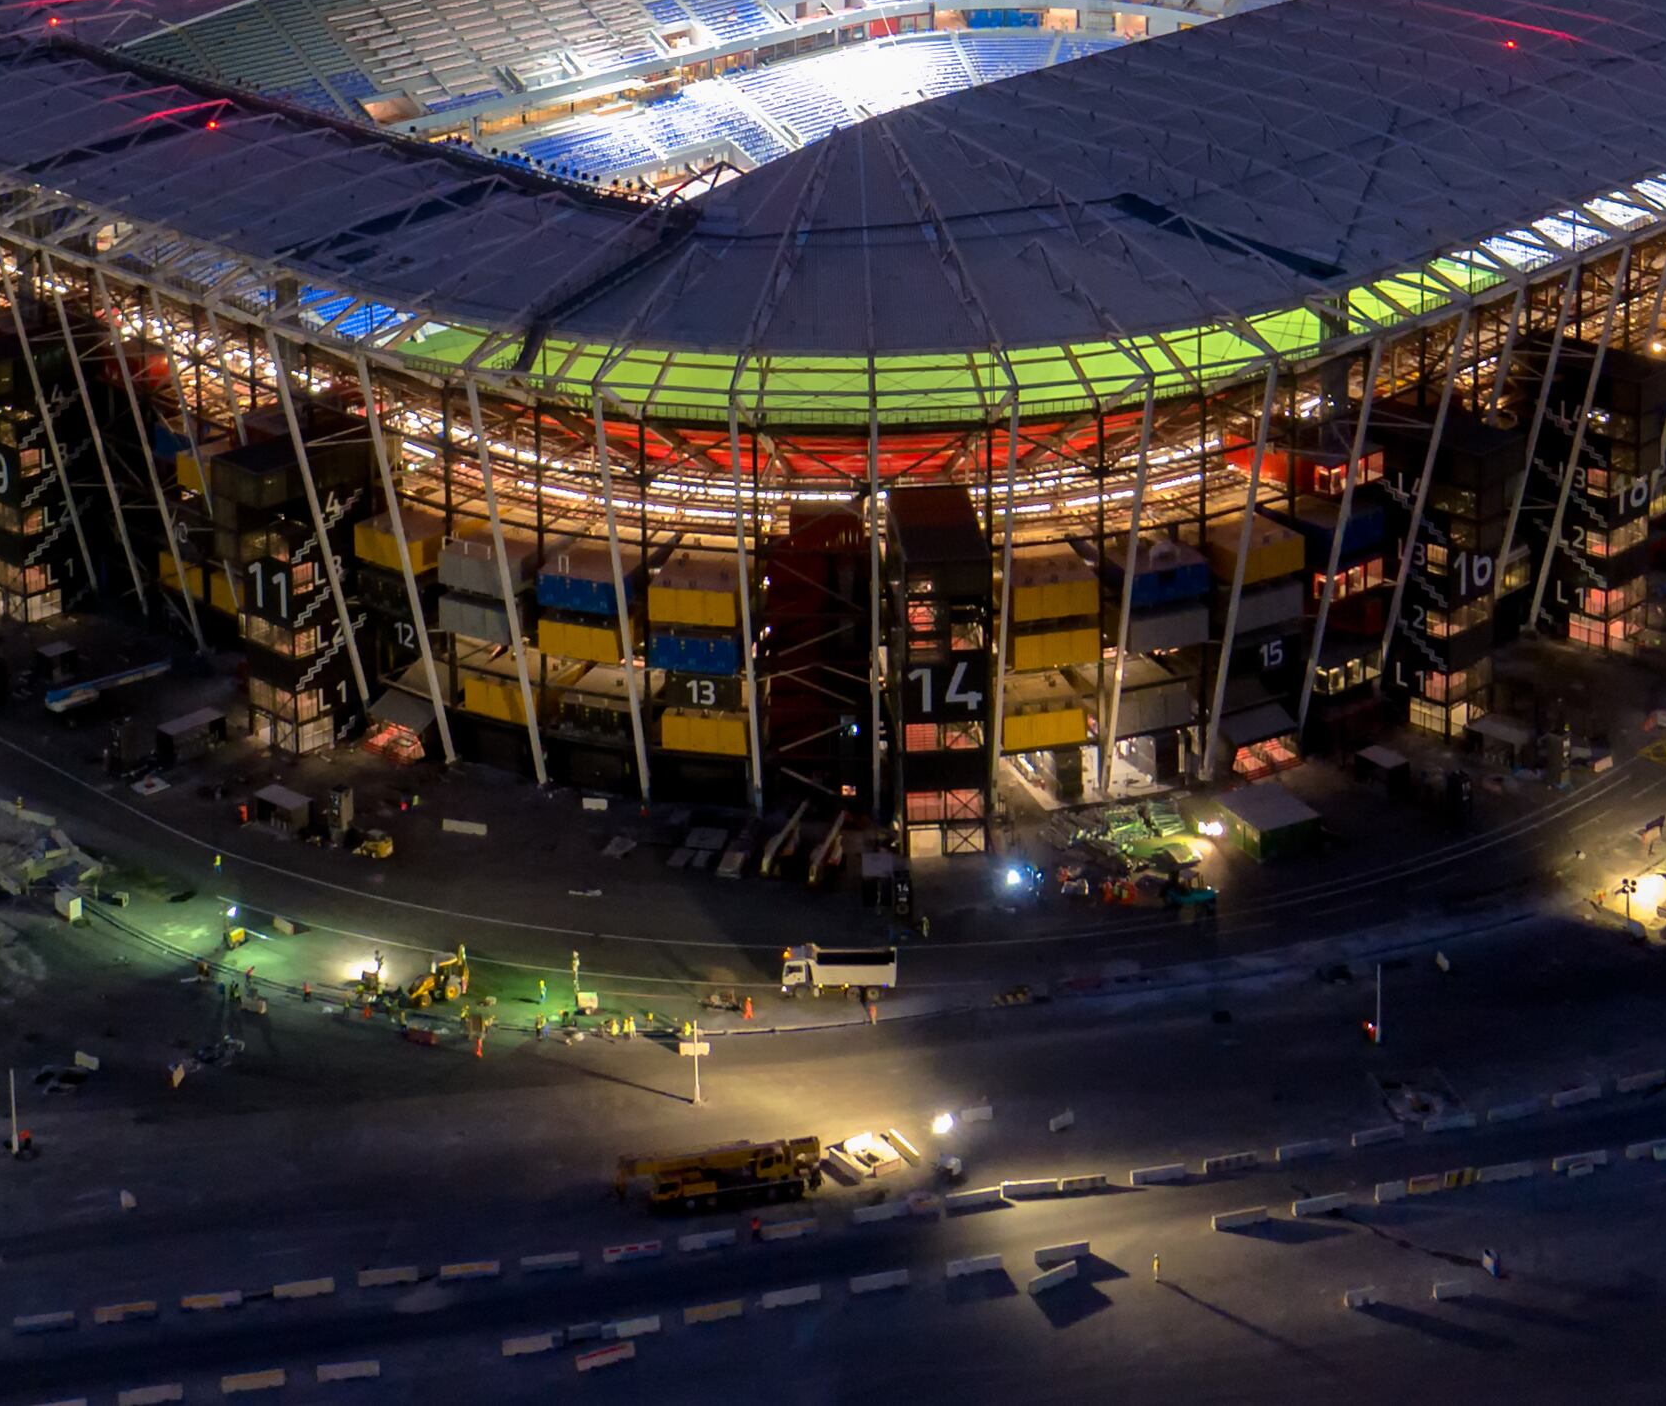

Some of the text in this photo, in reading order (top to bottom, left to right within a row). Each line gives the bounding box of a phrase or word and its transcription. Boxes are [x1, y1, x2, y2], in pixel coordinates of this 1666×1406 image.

[248, 561, 289, 619] 11
[393, 621, 415, 649] 12
[1259, 639, 1284, 667] 15
[686, 679, 715, 705] 13
[907, 661, 983, 714] 14
